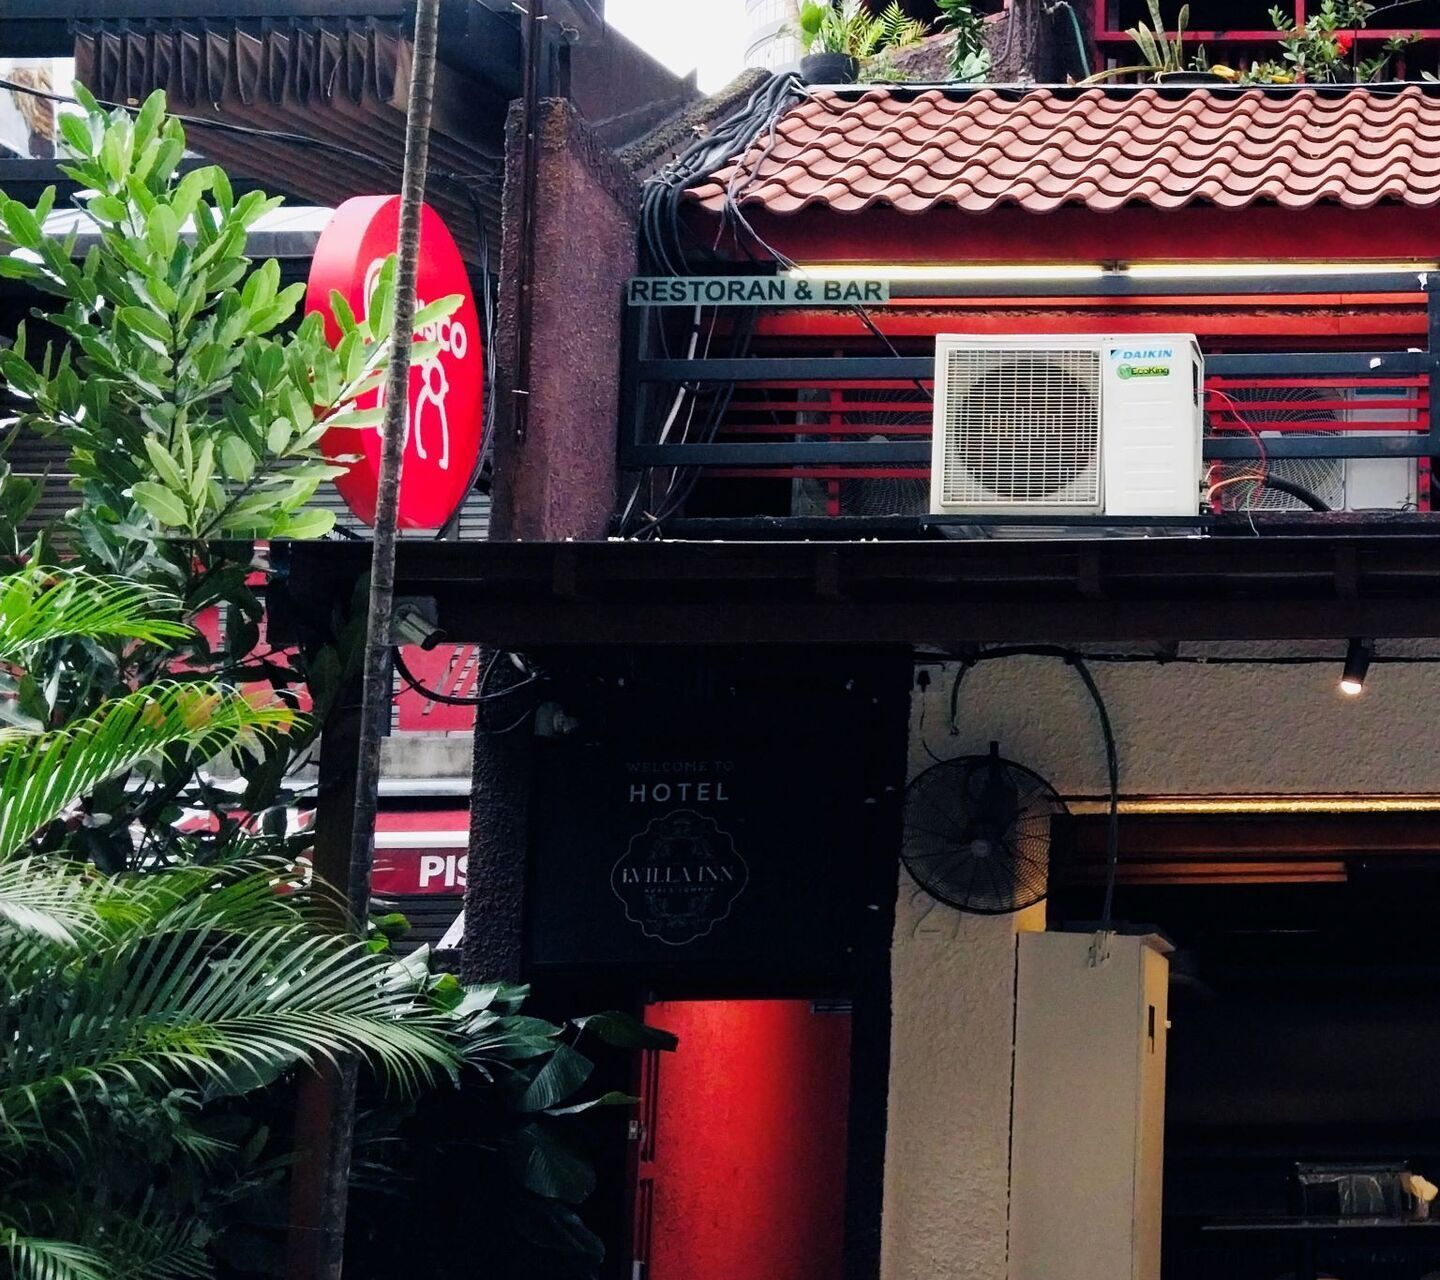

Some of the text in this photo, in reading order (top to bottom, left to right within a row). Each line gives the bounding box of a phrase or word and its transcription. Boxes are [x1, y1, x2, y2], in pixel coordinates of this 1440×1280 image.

[630, 279, 883, 303] RESTORAN & BAR
[1123, 349, 1173, 359] DAIKIN
[1131, 366, 1170, 377] EcoKing
[629, 782, 729, 802] HOTEL
